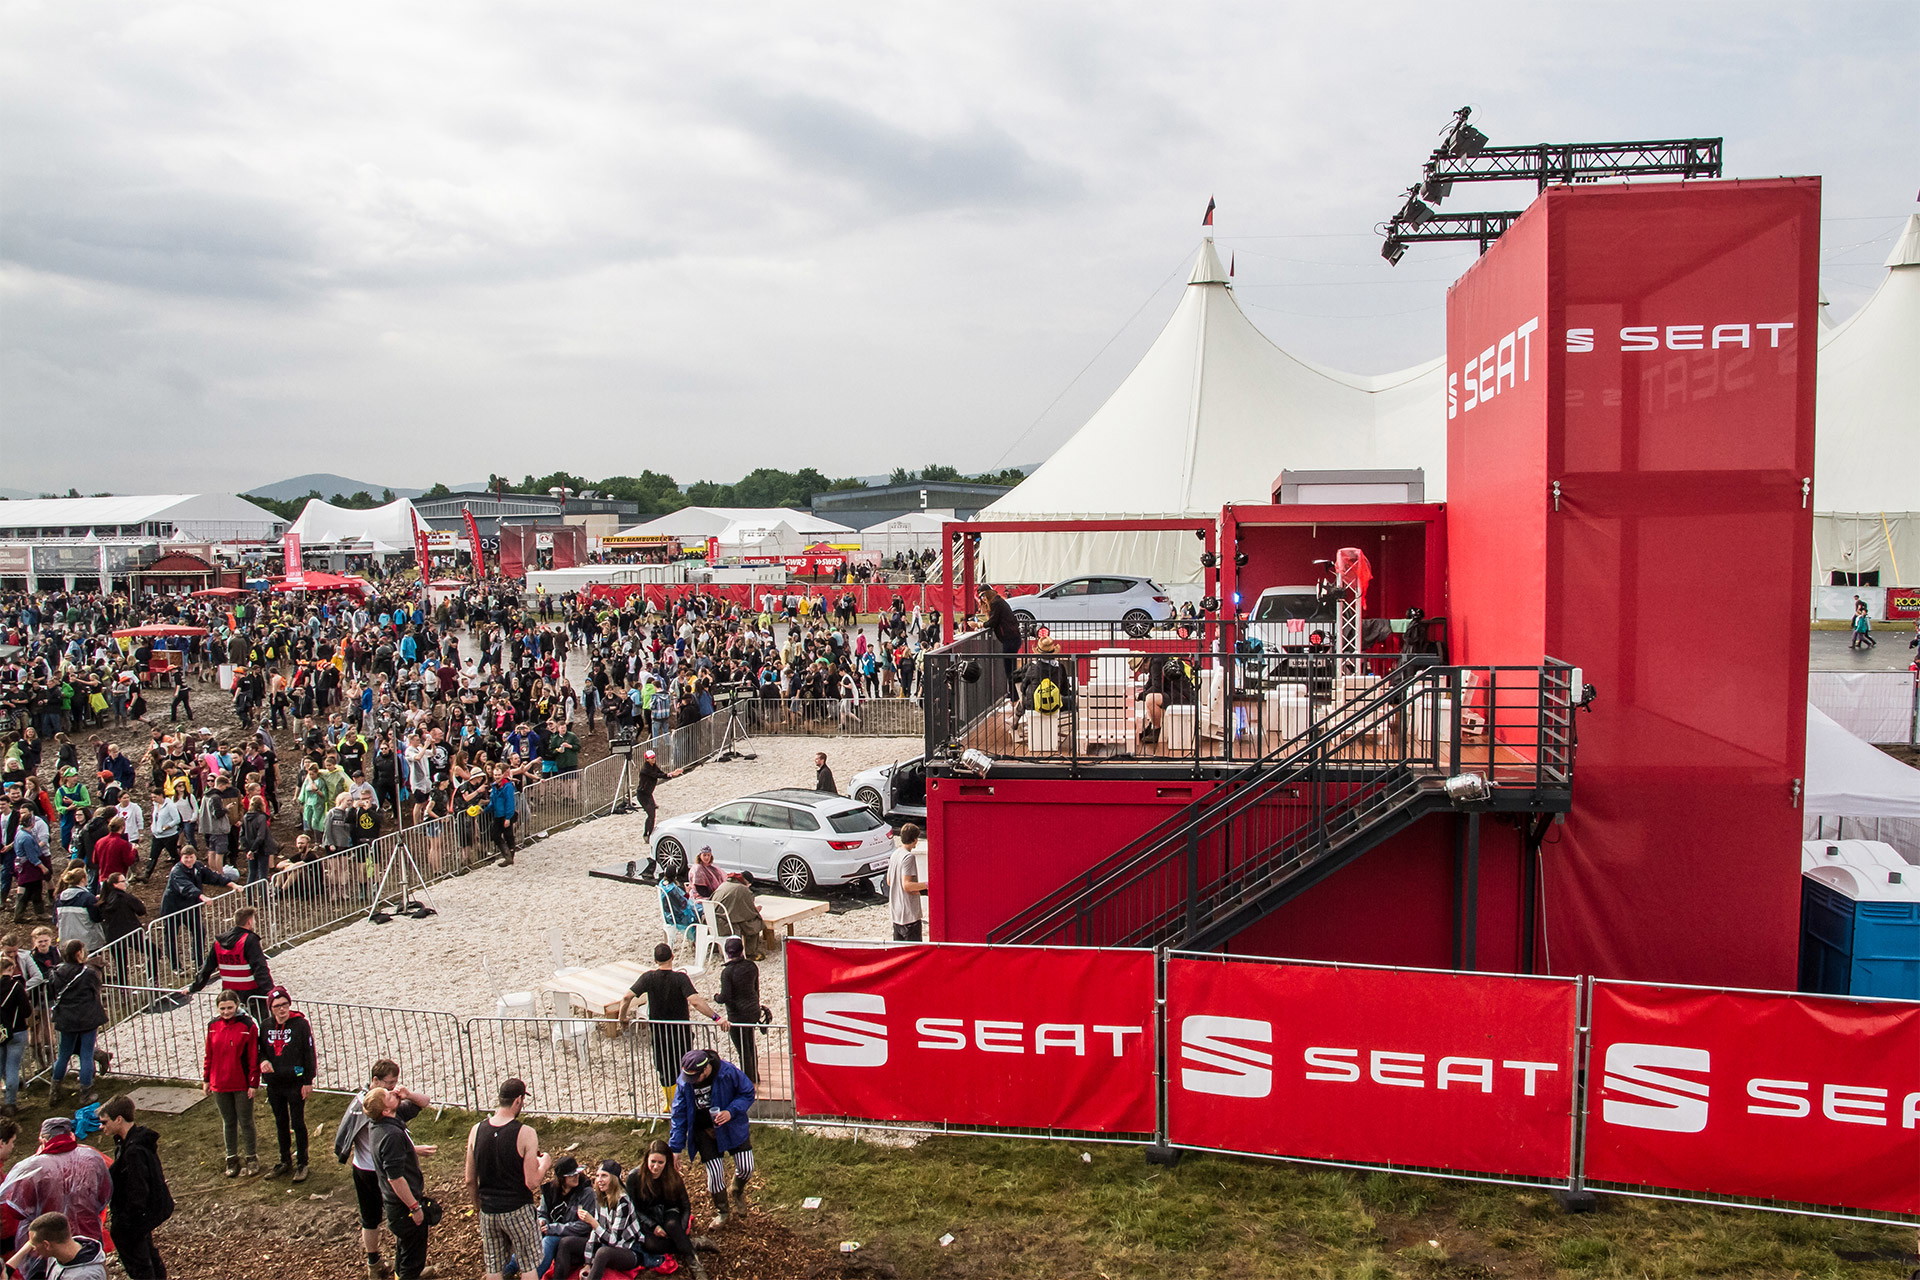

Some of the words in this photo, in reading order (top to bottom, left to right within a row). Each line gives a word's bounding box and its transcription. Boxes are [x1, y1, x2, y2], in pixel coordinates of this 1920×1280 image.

[1619, 322, 1794, 352] SEAT
[1463, 315, 1539, 413] SEAT
[920, 489, 928, 508] 5
[786, 558, 807, 567] SWR3
[821, 558, 842, 567] SWR3
[915, 1017, 1143, 1057] SEAT
[1304, 1046, 1559, 1097] SEAT
[1746, 1078, 1920, 1129] SE
